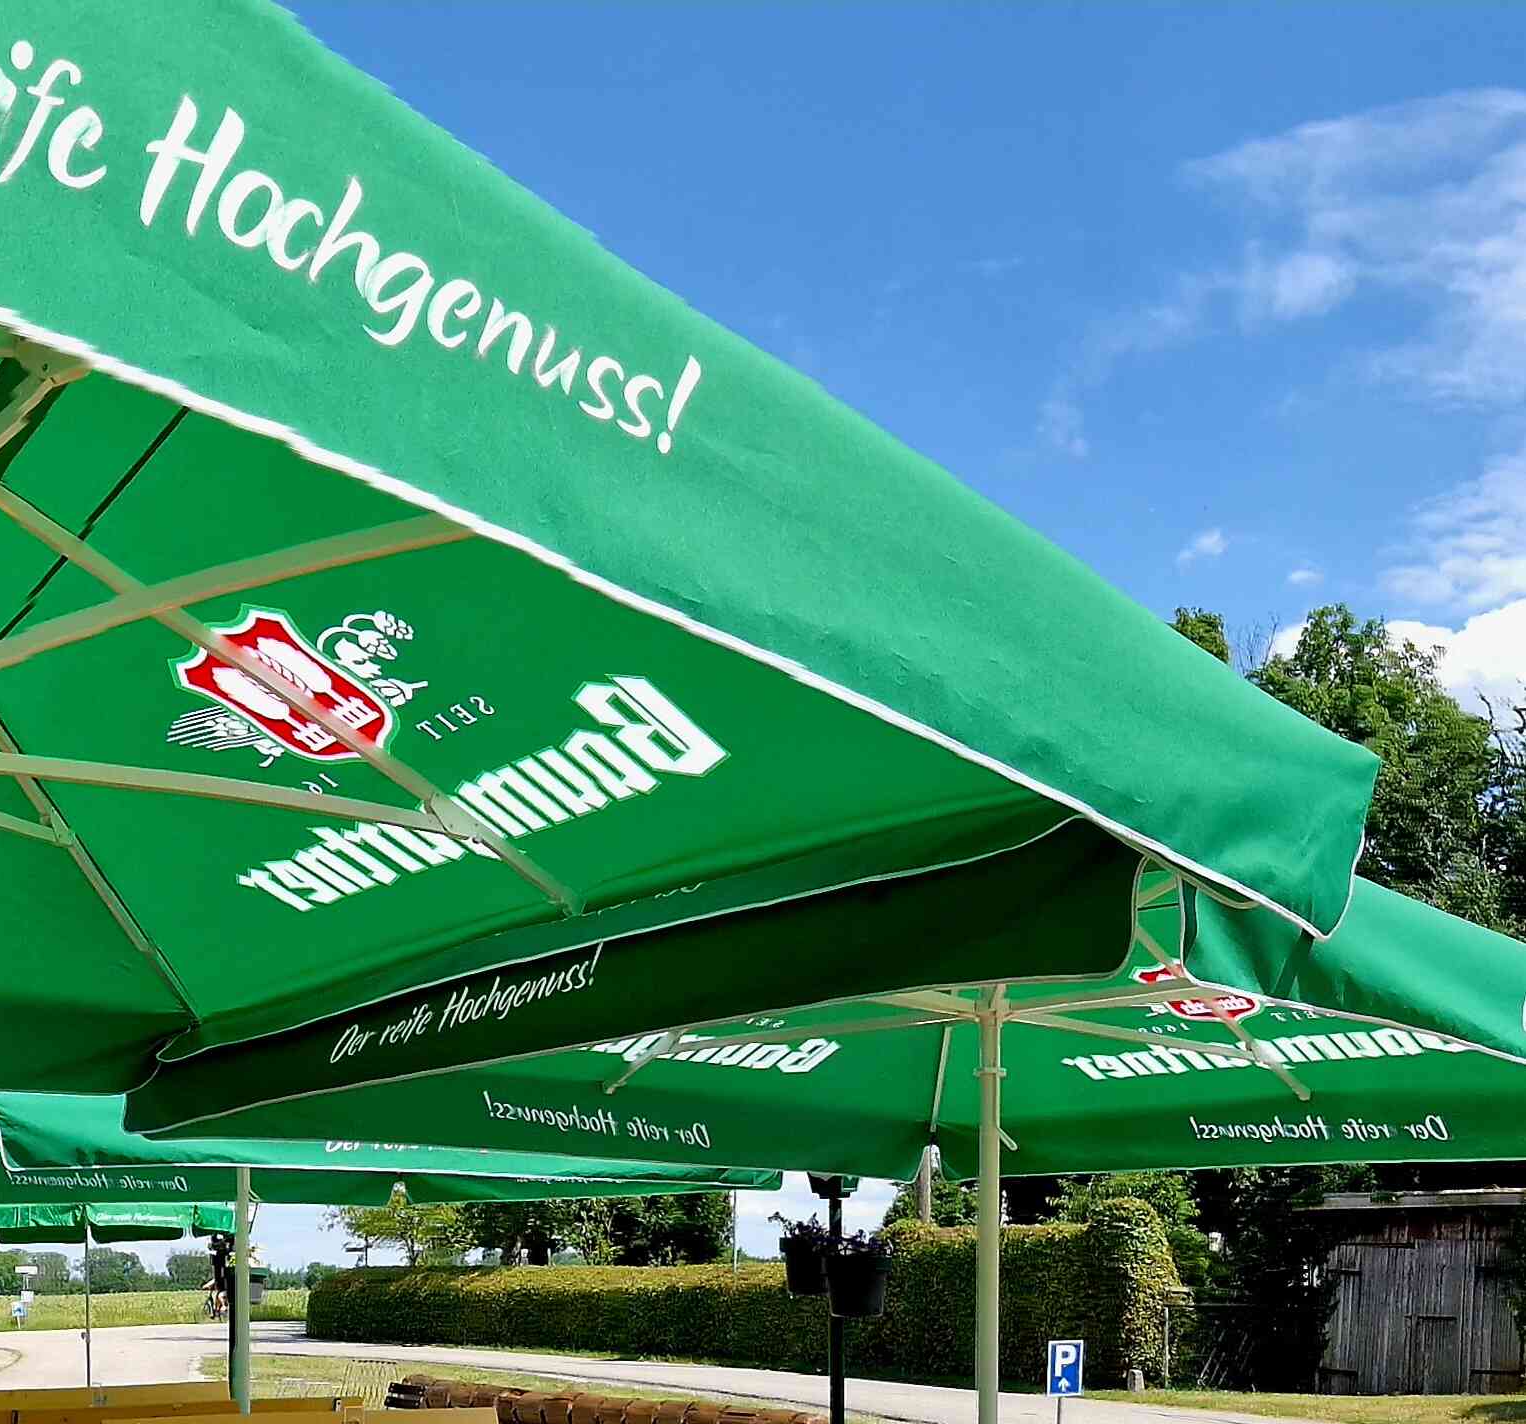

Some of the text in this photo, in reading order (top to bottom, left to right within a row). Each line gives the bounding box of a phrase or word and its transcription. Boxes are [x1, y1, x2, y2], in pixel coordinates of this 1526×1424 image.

[139, 94, 702, 454] Hochgenuss!
[329, 942, 604, 1064] Der reife Hochgenuss!
[1054, 1344, 1077, 1377] P
